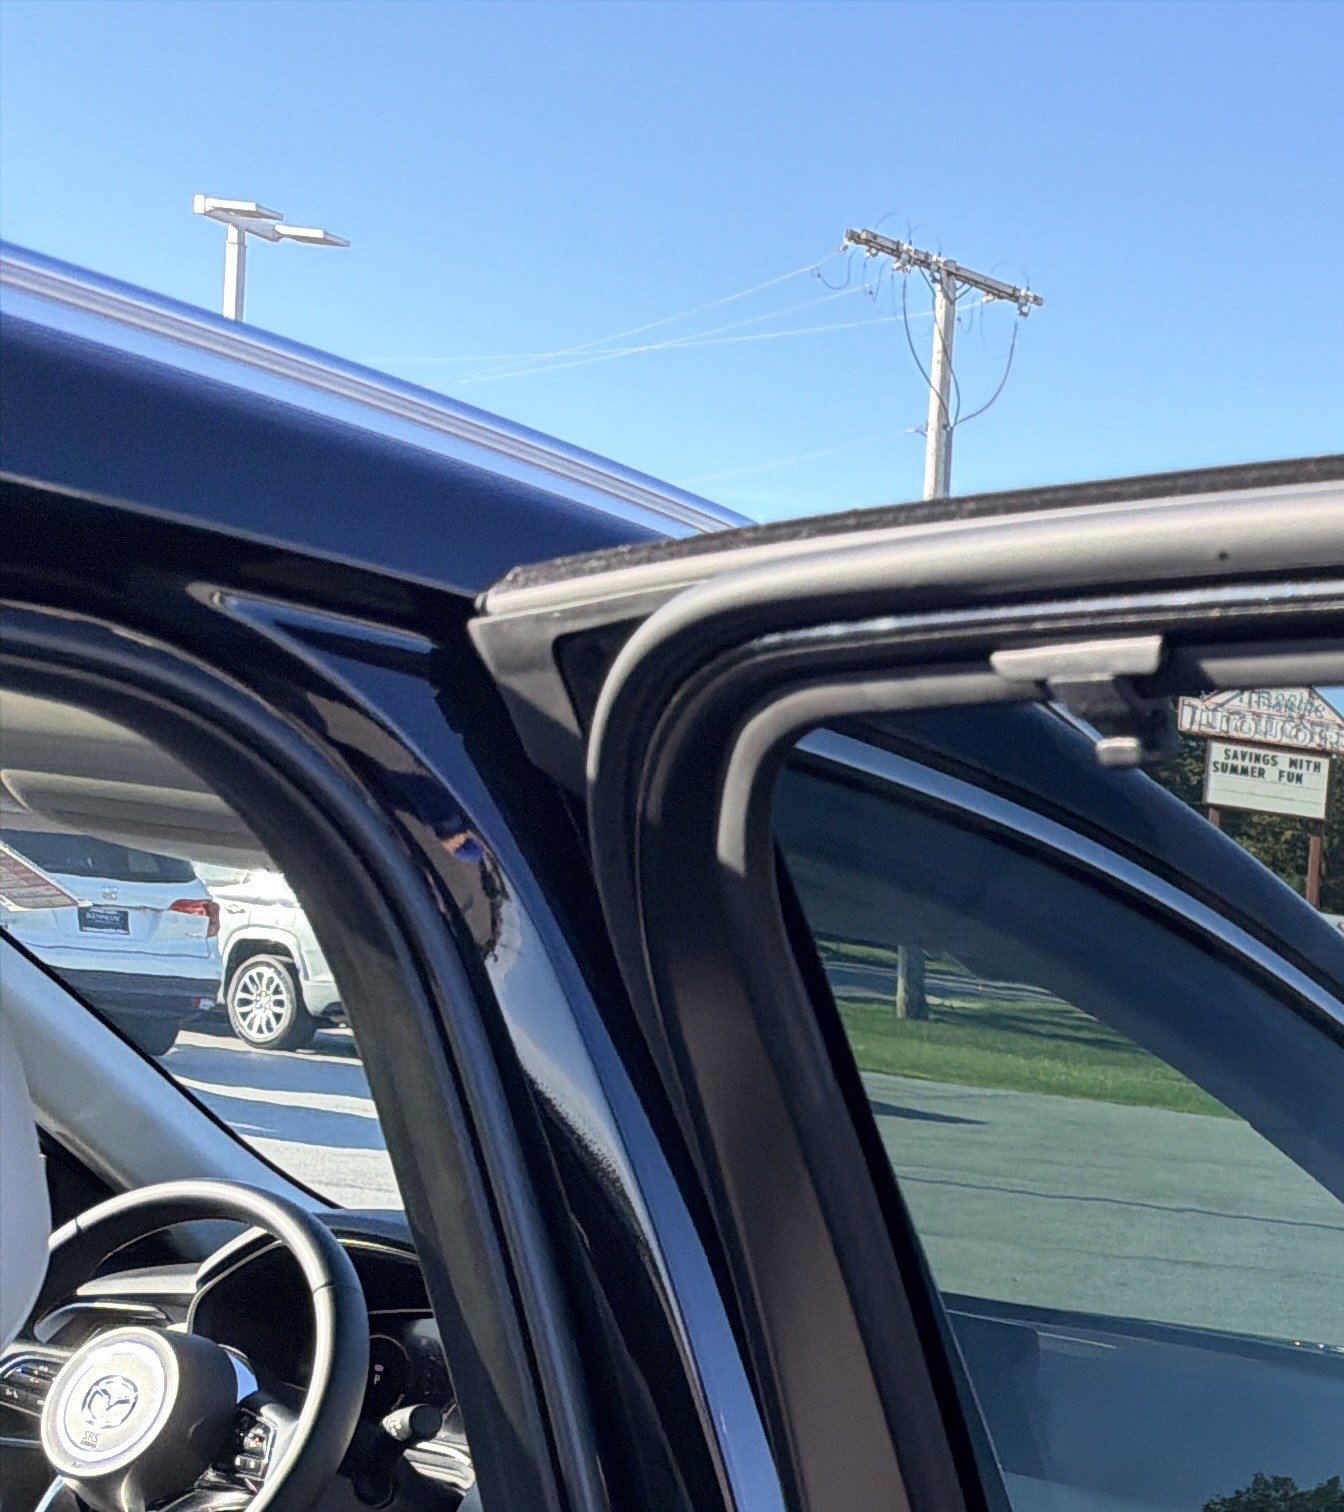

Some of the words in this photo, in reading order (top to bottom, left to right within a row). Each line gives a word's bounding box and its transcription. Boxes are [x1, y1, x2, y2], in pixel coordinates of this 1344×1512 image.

[1224, 748, 1279, 767] SAVINGS
[1289, 758, 1321, 773] WITH
[1212, 761, 1265, 779] SUMMER
[1278, 770, 1303, 785] FUN
